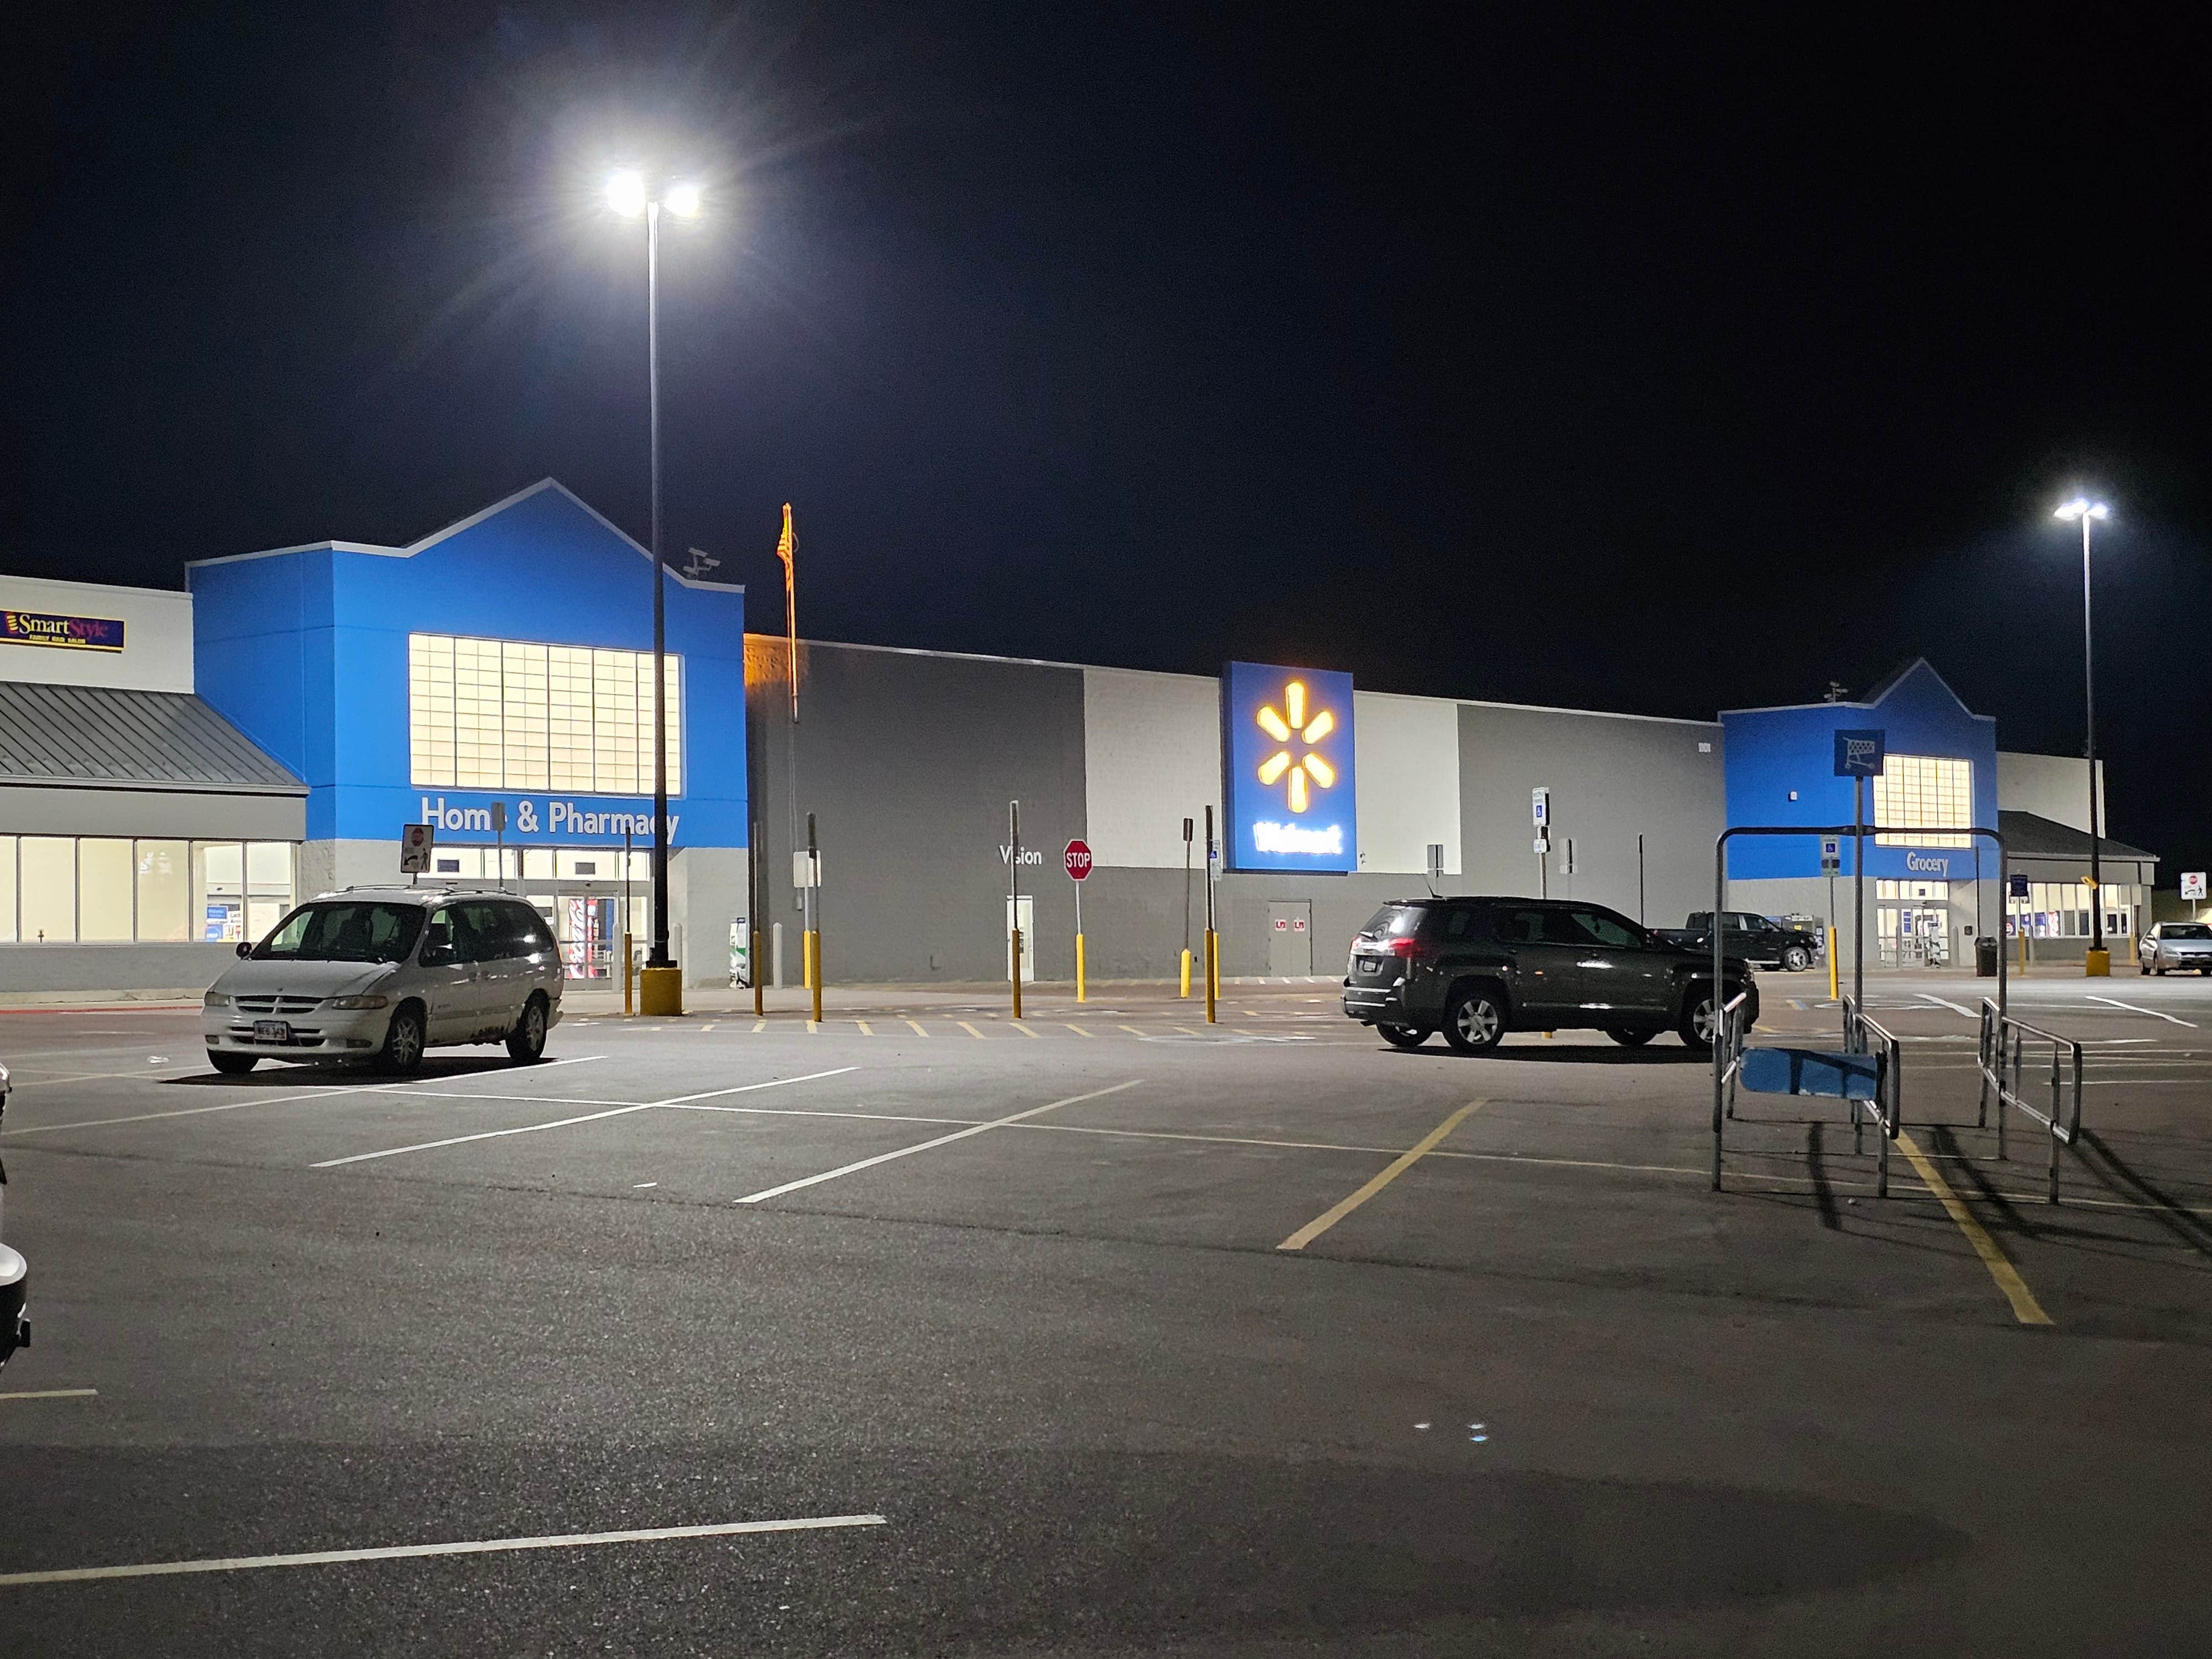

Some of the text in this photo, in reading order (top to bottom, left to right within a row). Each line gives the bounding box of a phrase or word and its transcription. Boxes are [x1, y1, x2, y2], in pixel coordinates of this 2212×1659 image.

[19, 614, 108, 639] SmartStyle
[421, 796, 508, 831] Hom
[517, 800, 539, 833] &
[999, 845, 1042, 865] Vsion
[1066, 852, 1090, 868] STOP
[1907, 852, 1949, 877] Grocery
